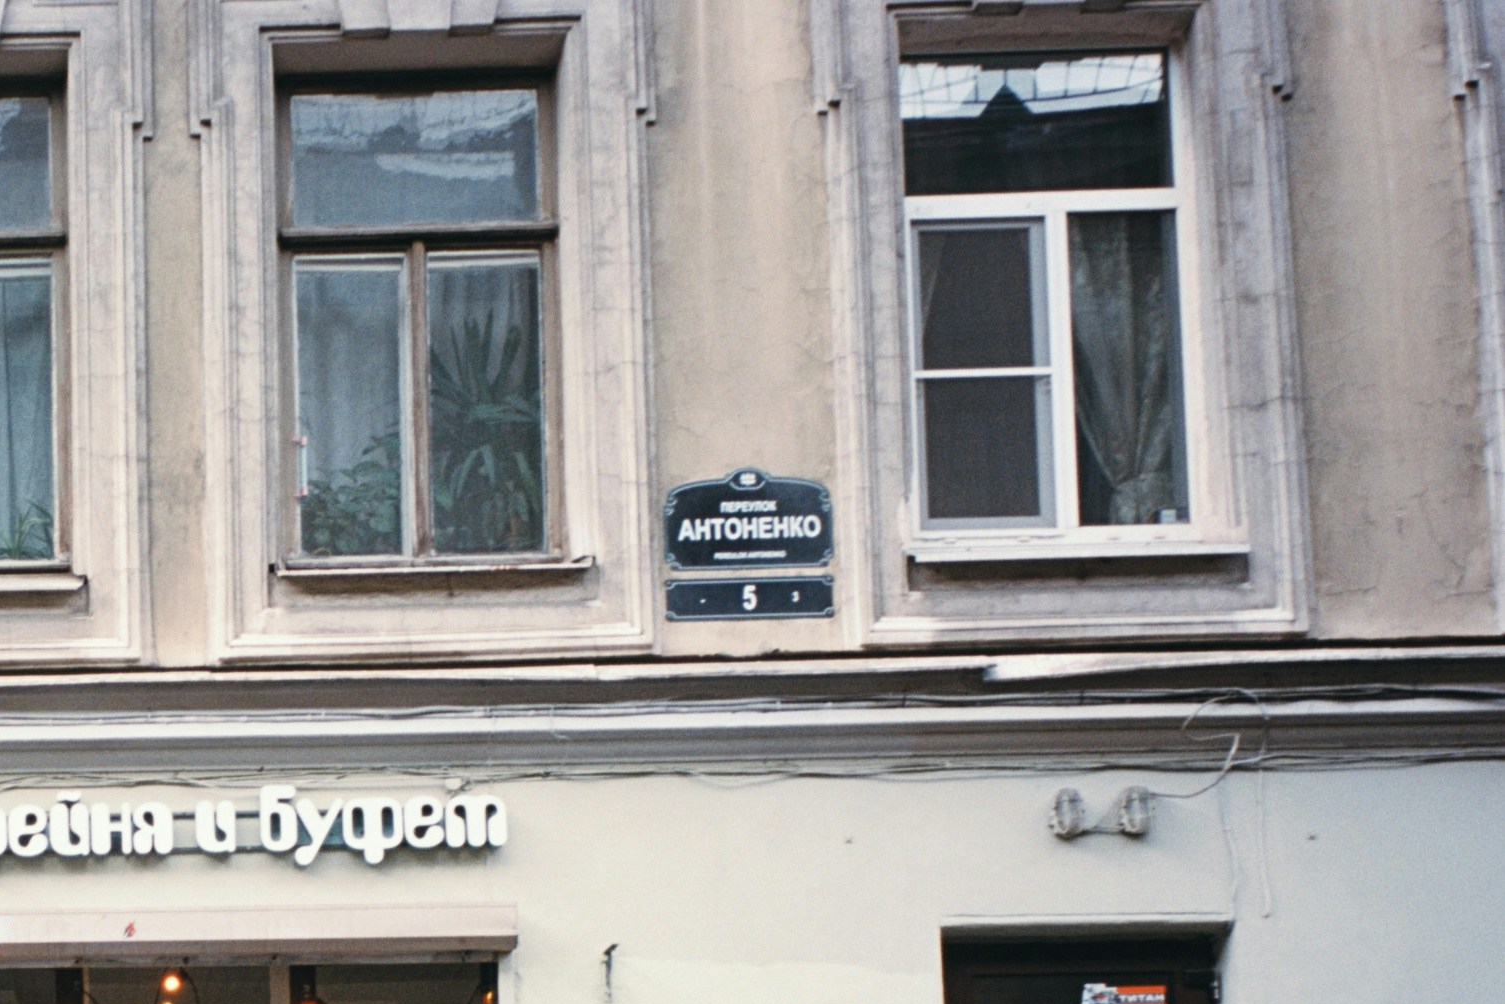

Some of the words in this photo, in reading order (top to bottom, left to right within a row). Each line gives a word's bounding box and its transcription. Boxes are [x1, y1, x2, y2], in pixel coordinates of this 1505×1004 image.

[720, 501, 777, 513] ПЕРЕУЛОК
[678, 515, 821, 541] АНТОНЕНКО
[742, 585, 758, 611] 5
[194, 800, 236, 853] и
[259, 784, 507, 865] буфет
[1119, 993, 1165, 1003] ТИТАН
